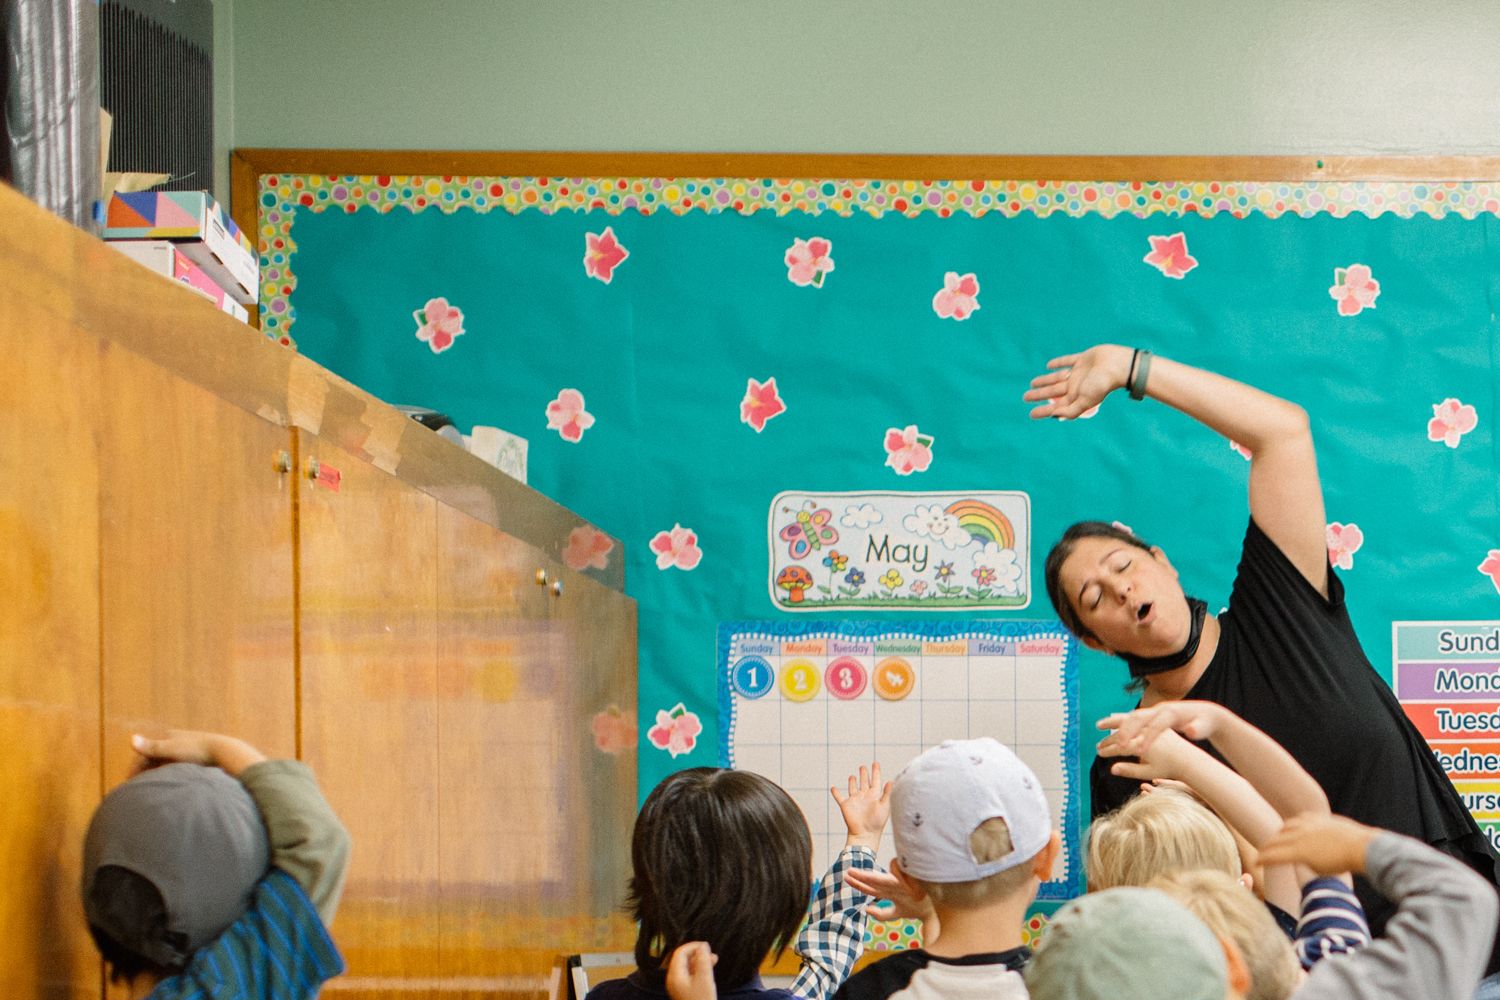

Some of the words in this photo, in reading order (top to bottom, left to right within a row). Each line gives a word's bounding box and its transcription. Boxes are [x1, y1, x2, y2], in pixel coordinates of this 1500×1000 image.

[865, 534, 928, 572] May
[741, 643, 773, 654] Sunday
[786, 643, 823, 655] Monday
[833, 643, 869, 655] Tuesday
[978, 643, 1006, 655] Friday
[1020, 643, 1060, 655] Saturday
[747, 667, 758, 688] 1
[793, 670, 807, 691] 2
[838, 667, 854, 690] 3
